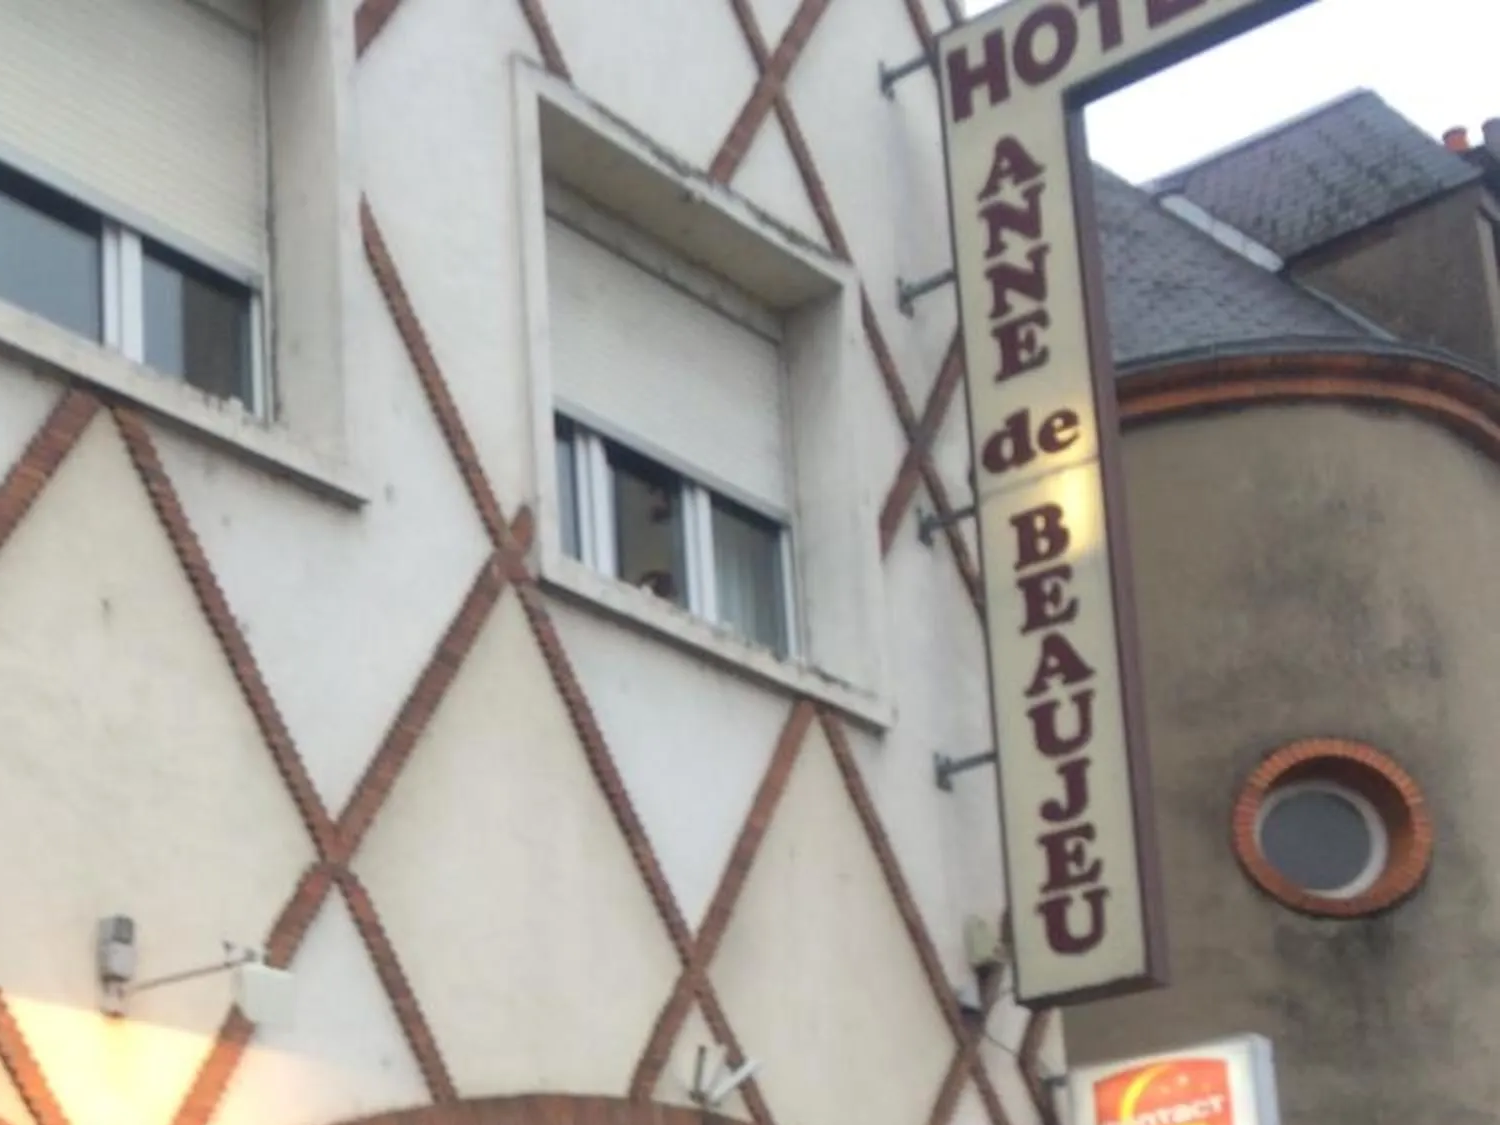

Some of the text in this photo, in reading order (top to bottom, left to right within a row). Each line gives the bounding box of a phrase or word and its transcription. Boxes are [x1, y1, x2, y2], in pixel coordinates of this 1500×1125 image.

[978, 135, 1050, 383] ANNE
[981, 408, 1080, 473] de
[1010, 503, 1110, 956] BEAUJEU
